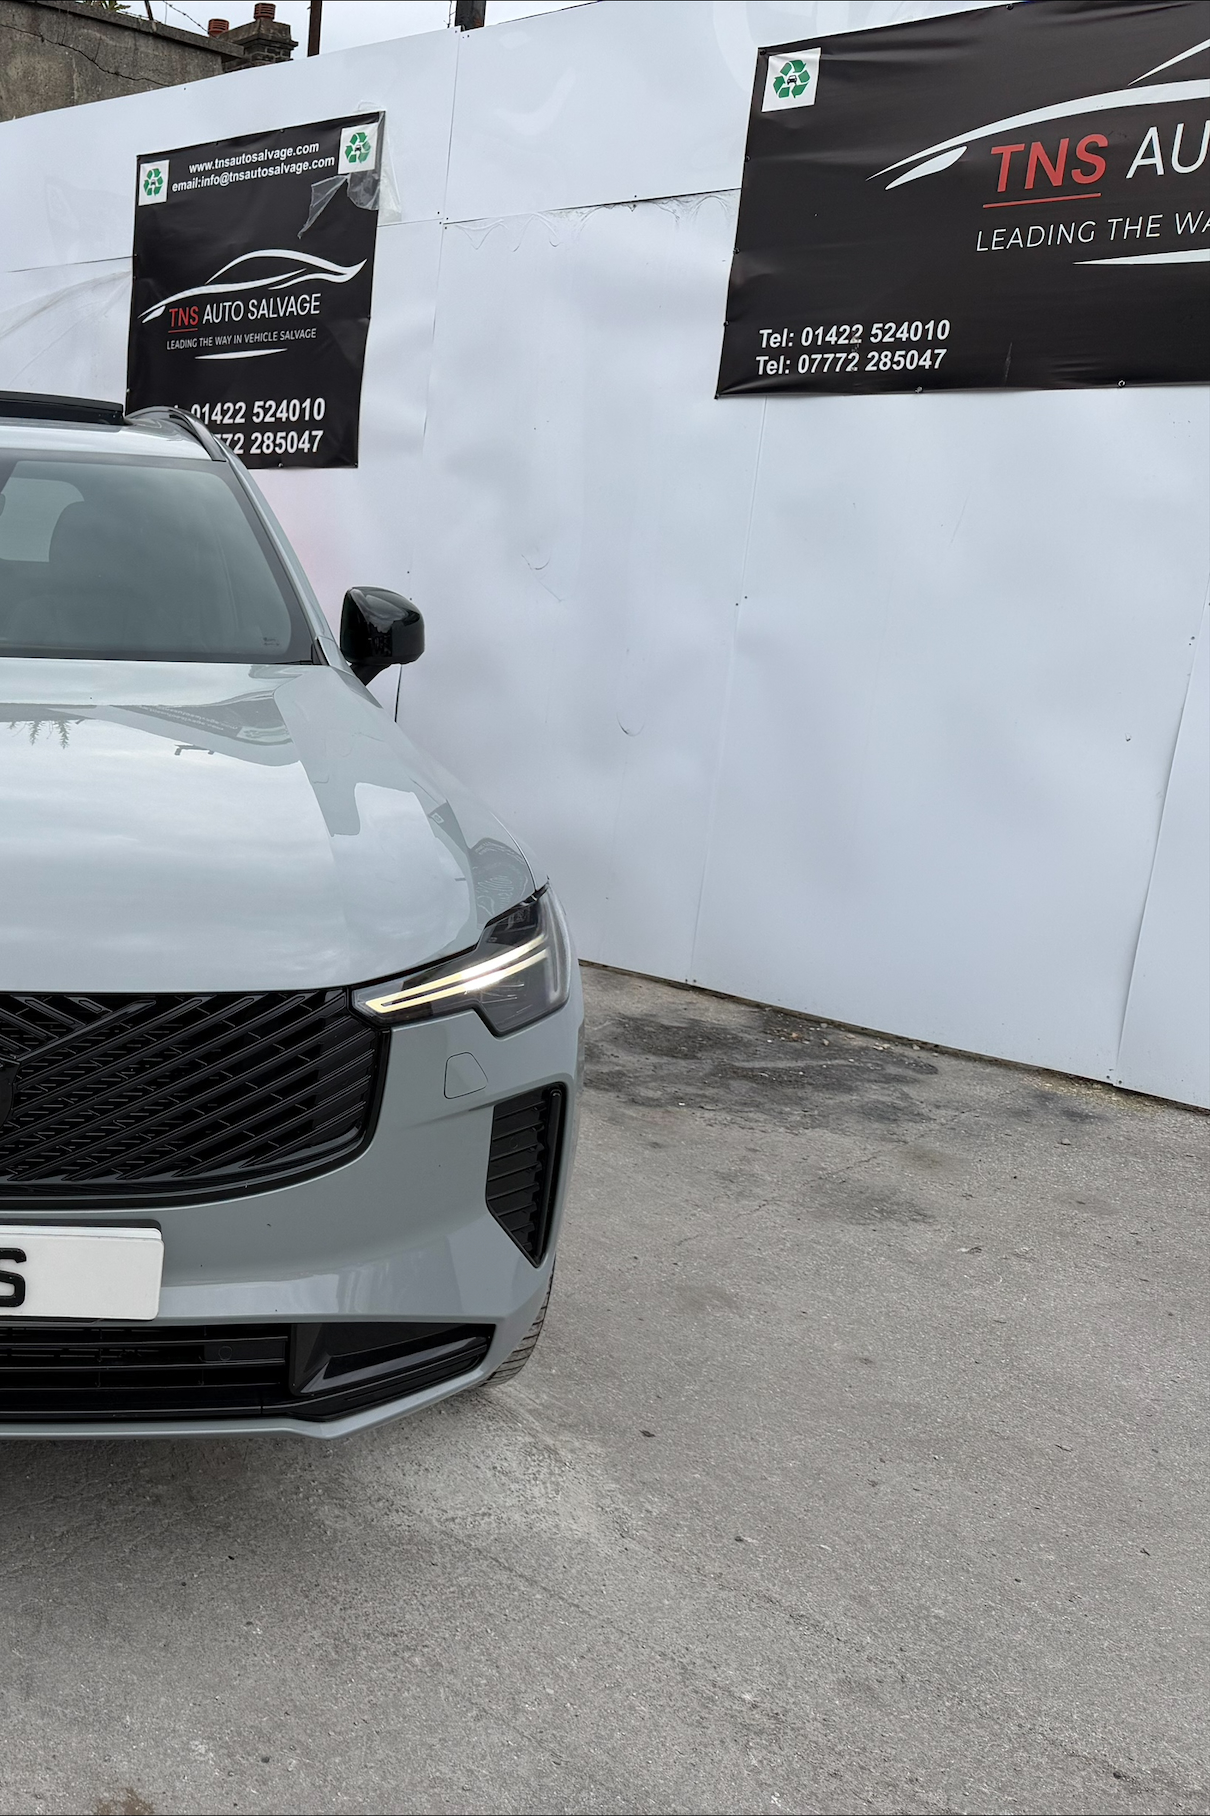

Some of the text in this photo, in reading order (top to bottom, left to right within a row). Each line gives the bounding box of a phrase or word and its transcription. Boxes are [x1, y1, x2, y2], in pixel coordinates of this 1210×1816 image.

[189, 142, 320, 173] www.tnsautosalvage.com
[990, 119, 1210, 192] TNS AU
[172, 156, 335, 192] email:info@tnsautosalvage.com
[976, 219, 1096, 252] LEADING
[1107, 214, 1163, 241] THE
[169, 293, 321, 327] TNS AUTO SALVAGE
[166, 328, 317, 350] LEADING THE WAY IN VEHICLE SALVAGE
[759, 319, 951, 348] Tel: 01422 524010
[756, 349, 947, 375] Tel: 07772 285047
[252, 397, 326, 423] 524010
[250, 430, 324, 454] 285047
